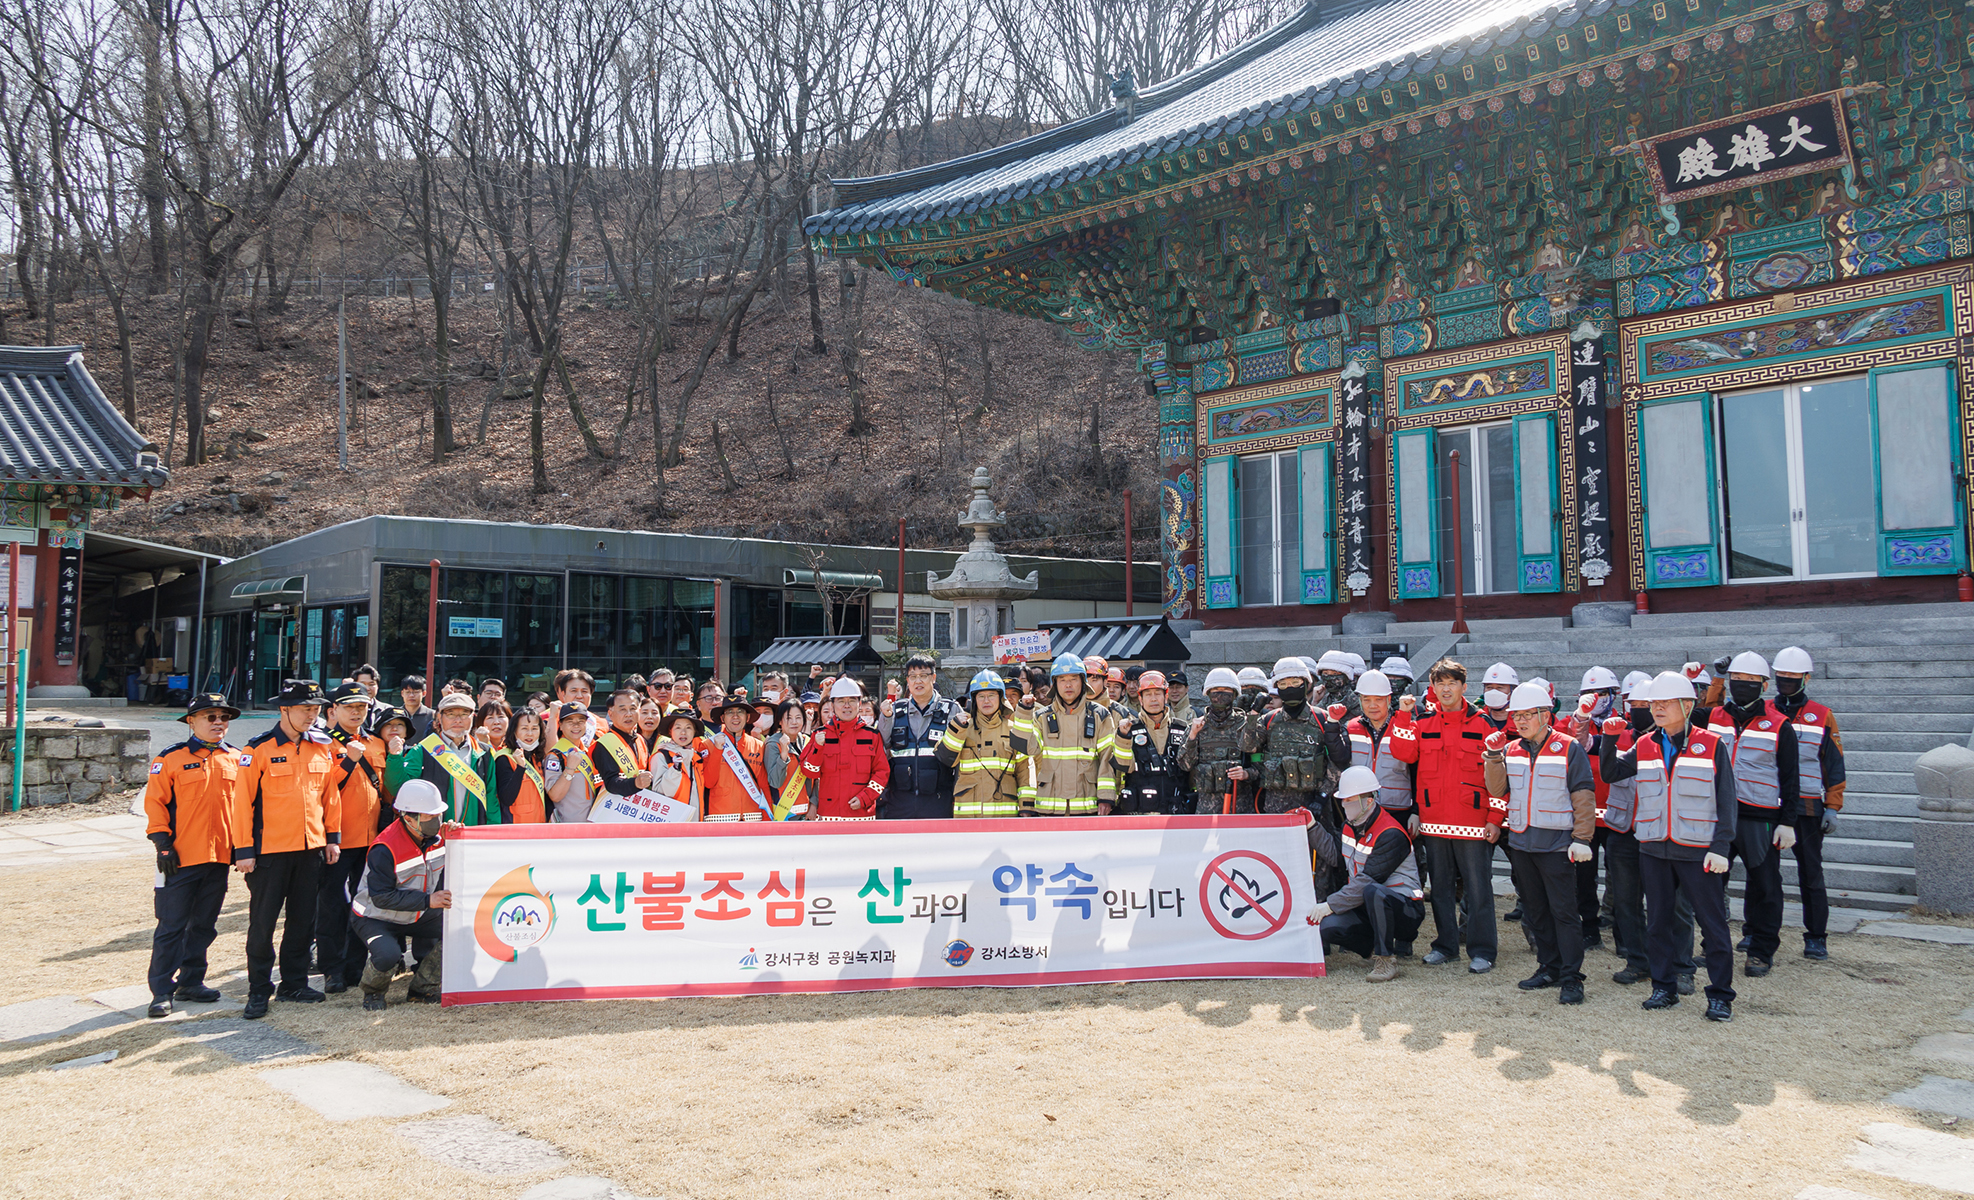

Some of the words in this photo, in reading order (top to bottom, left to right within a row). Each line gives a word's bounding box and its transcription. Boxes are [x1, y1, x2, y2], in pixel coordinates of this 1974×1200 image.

[1676, 116, 1828, 184] 大雄殿
[998, 637, 1017, 647] 산불은
[1020, 635, 1039, 644] 한순간
[615, 746, 635, 774] 산에서
[604, 799, 613, 809] 숲
[614, 802, 638, 818] 사랑의
[577, 868, 837, 932] 산불조심은
[857, 865, 967, 924] 산과의
[992, 861, 1185, 921] 약속입니다
[505, 932, 536, 941] 산불조심
[765, 952, 819, 966] 강서구청
[827, 950, 896, 965] 공원녹지과
[947, 947, 975, 961] 119
[981, 946, 1048, 960] 강서소방서
